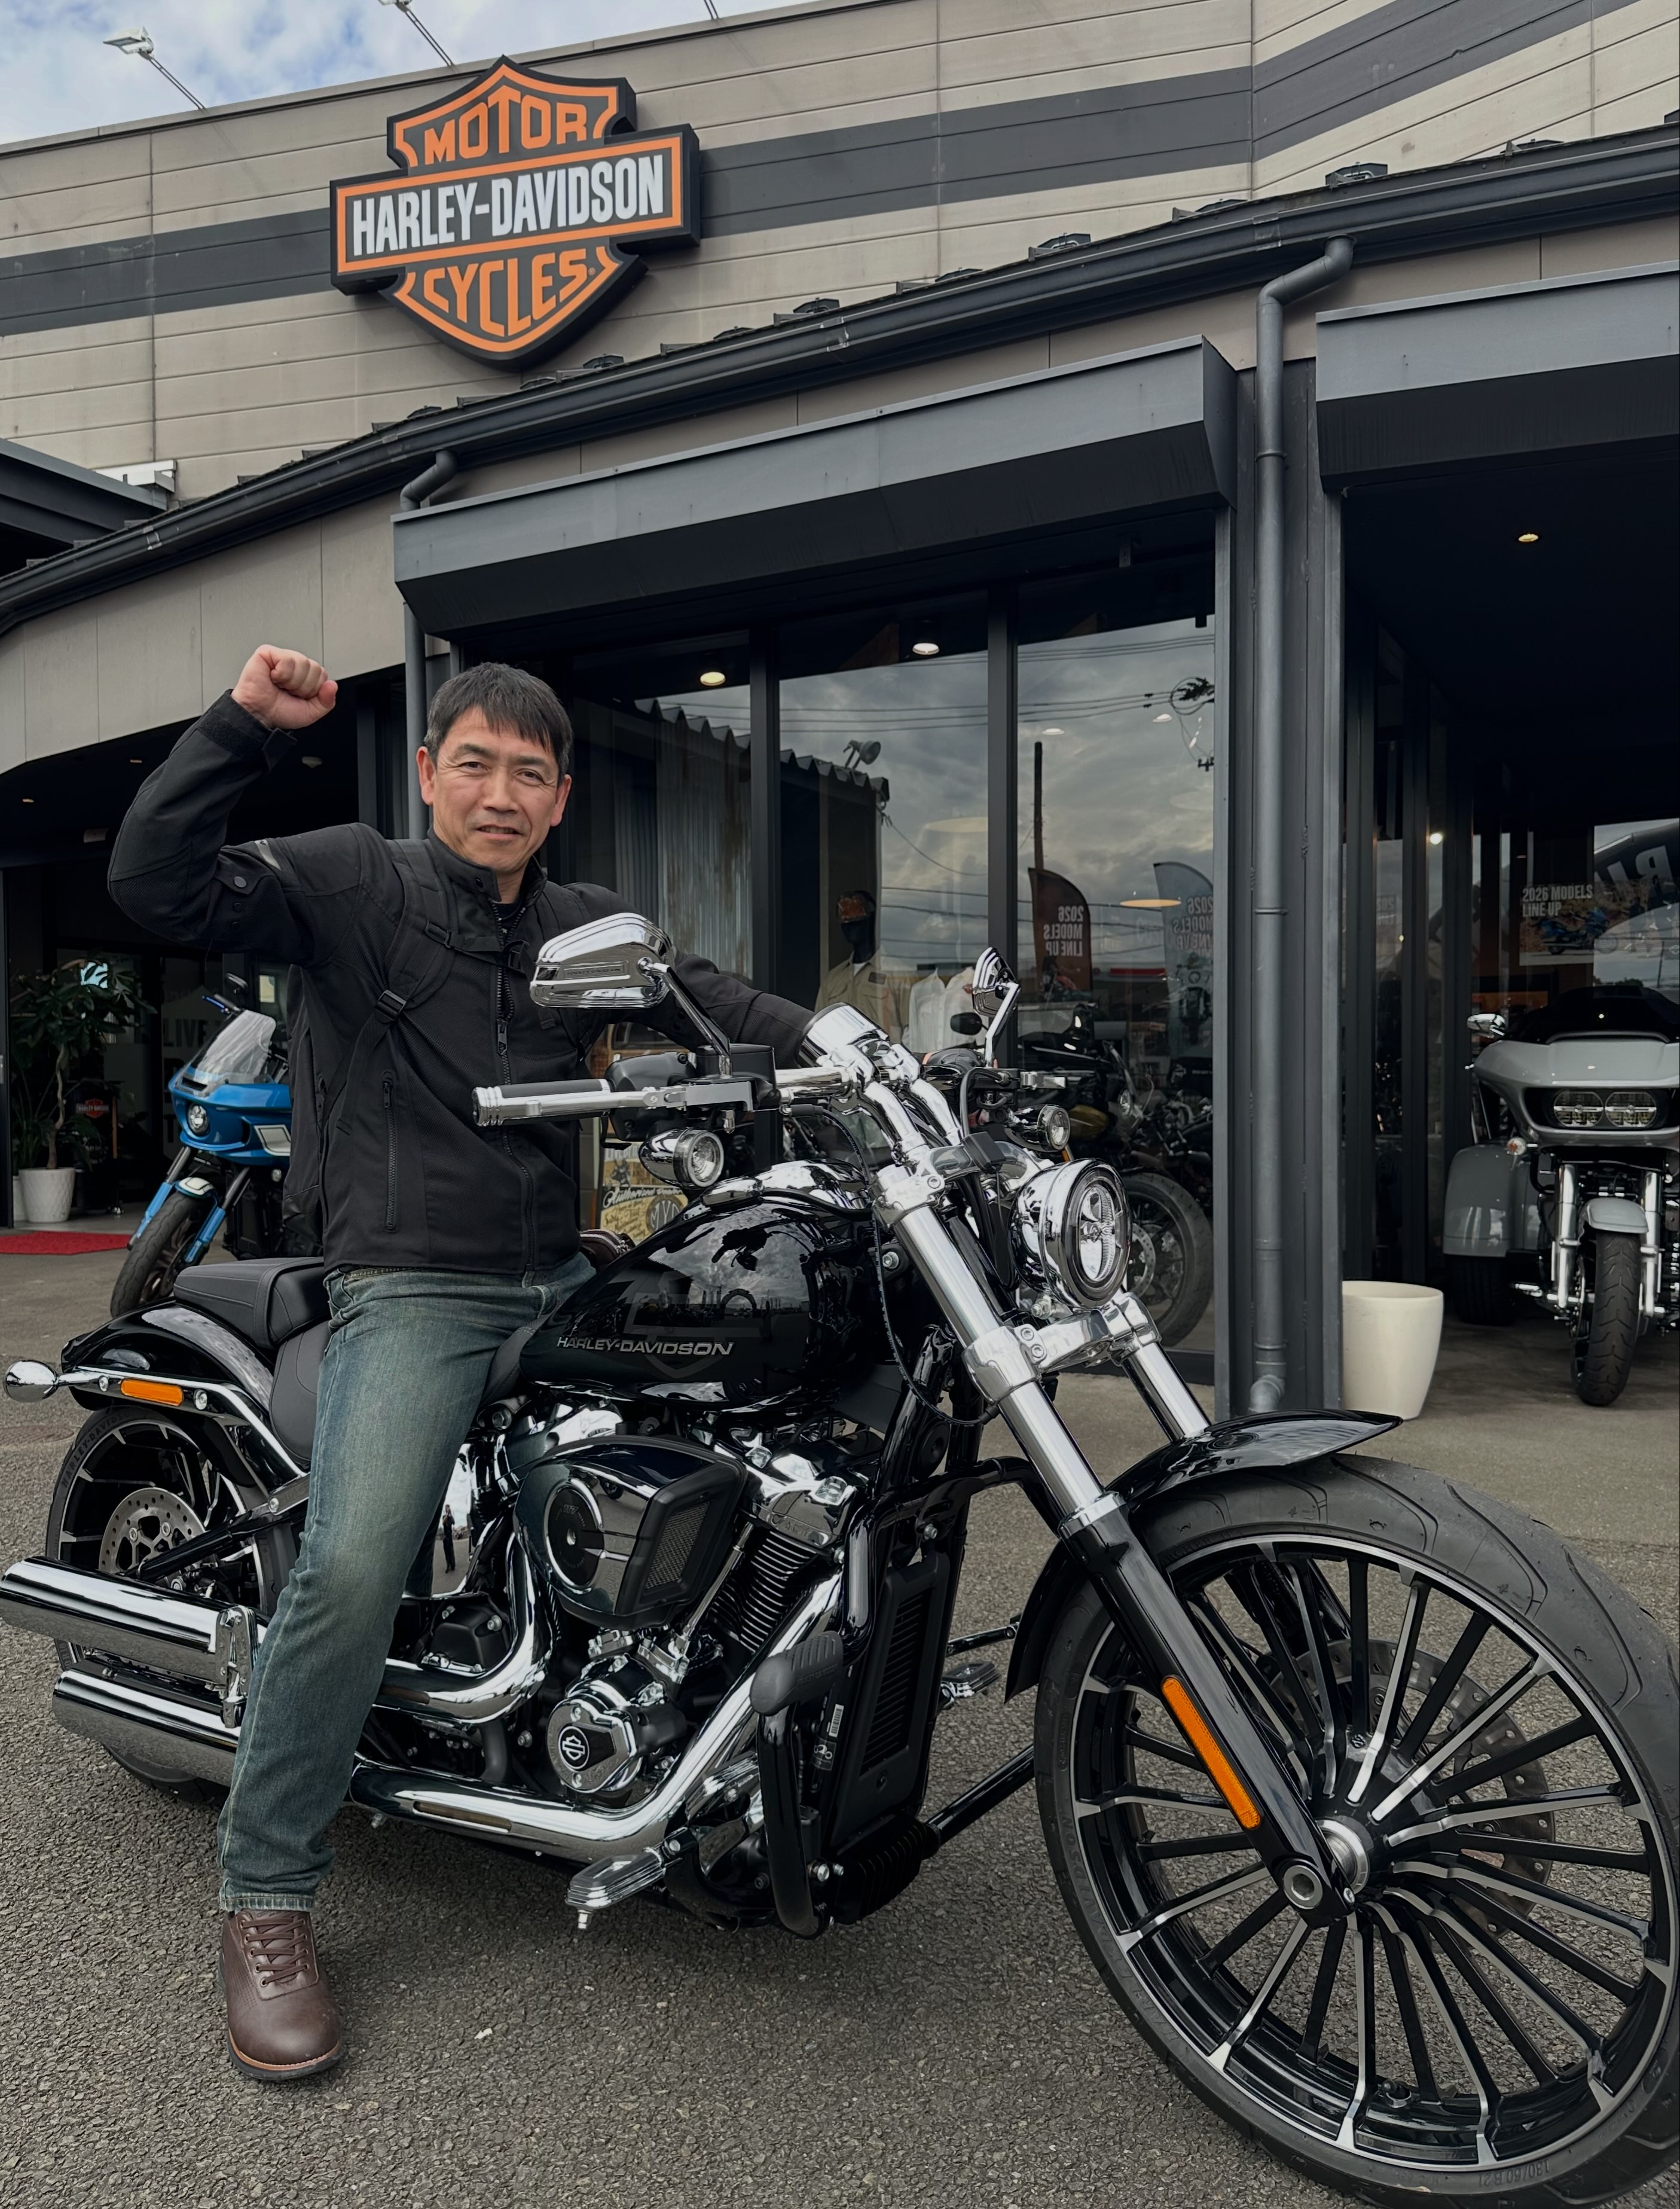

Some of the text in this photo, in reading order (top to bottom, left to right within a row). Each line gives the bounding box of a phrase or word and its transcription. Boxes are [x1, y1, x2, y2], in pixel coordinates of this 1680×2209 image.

[424, 84, 587, 165] MOTOR
[353, 154, 664, 256] HARLEY-DAVIDSON
[1522, 884, 1593, 902] 2026 MODELS
[1522, 901, 1562, 917] LINE UP
[556, 1336, 735, 1356] HARLEY-DAVIDSON
[563, 1504, 579, 1514] 117
